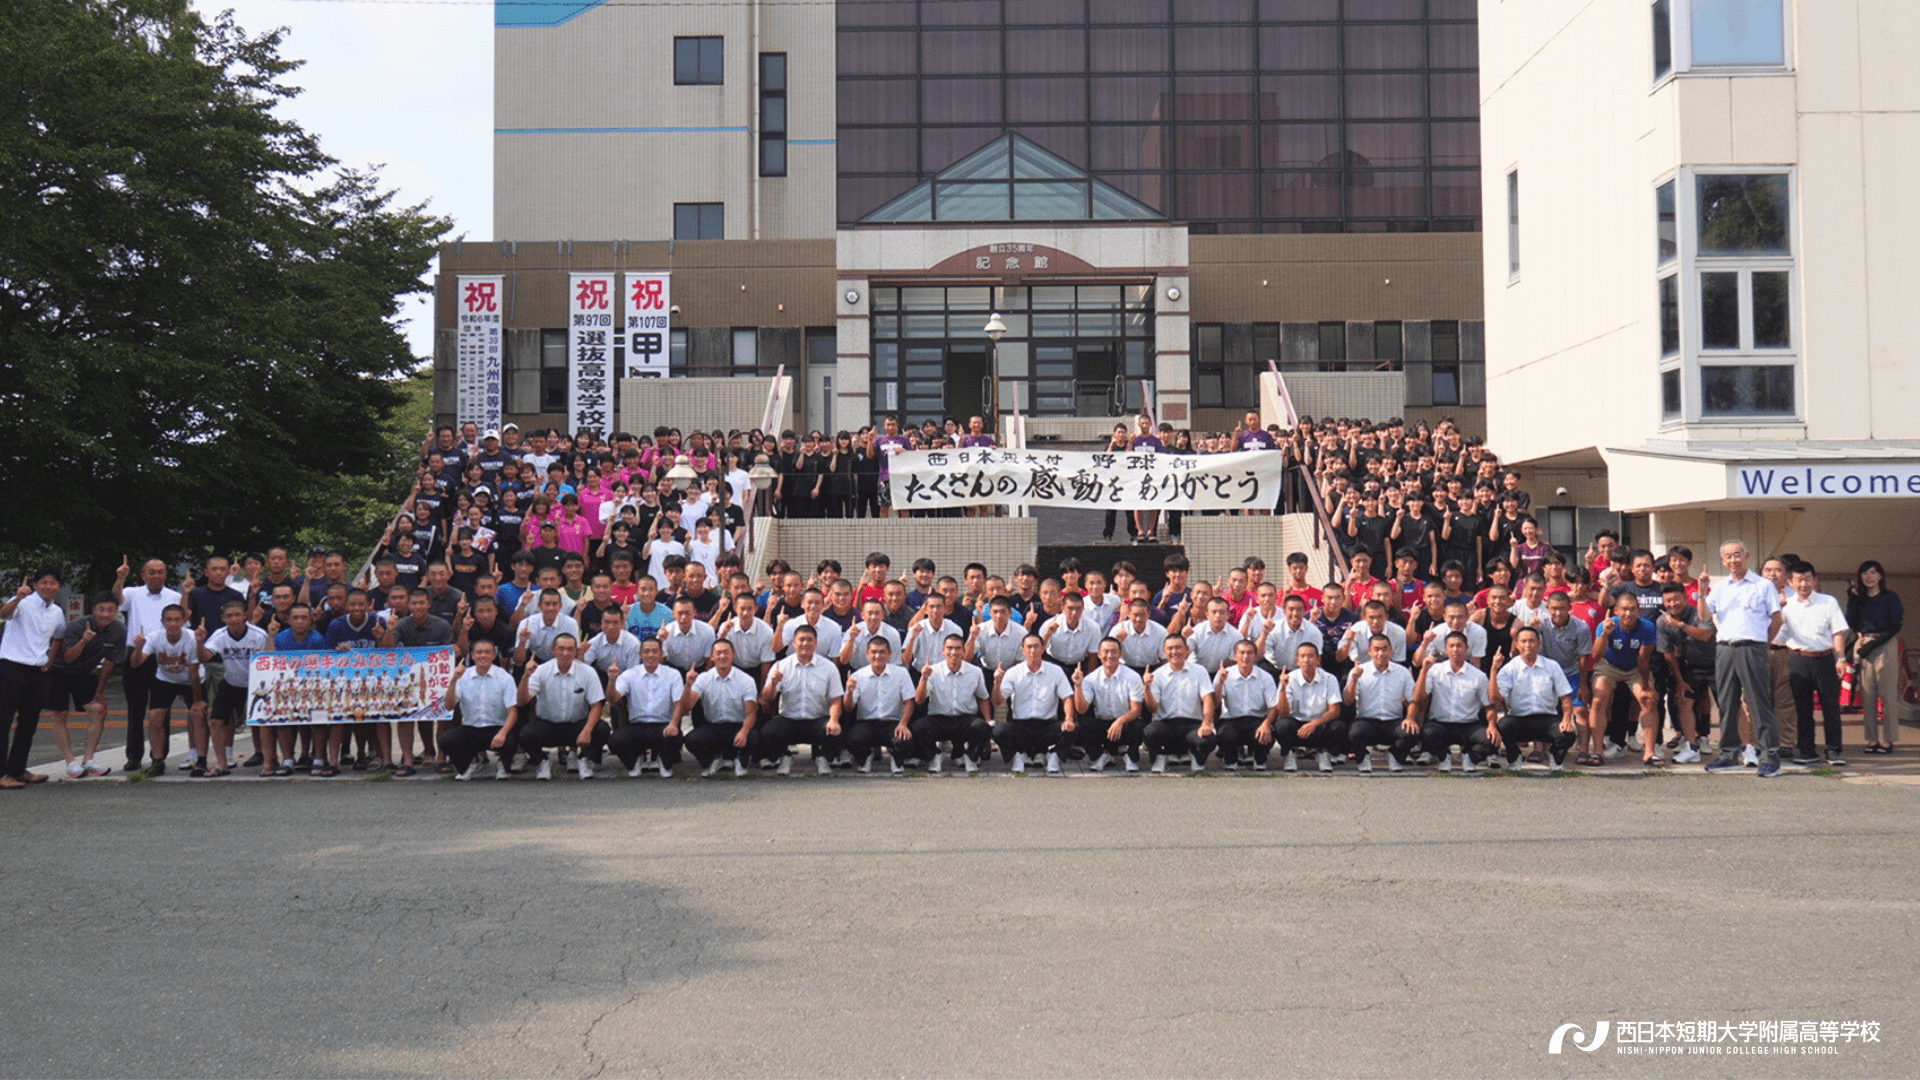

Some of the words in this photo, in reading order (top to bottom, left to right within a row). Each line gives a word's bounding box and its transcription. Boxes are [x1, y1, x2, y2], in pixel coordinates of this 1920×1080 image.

[990, 244, 1034, 253] 創立35周年
[976, 256, 1049, 270] 記念館
[464, 282, 497, 312] 祝
[575, 279, 609, 310] 祝
[631, 279, 665, 310] 祝
[573, 314, 611, 327] 第97回
[627, 316, 668, 329] 第107回
[632, 332, 662, 378] 甲
[1741, 468, 1920, 494] Welcome
